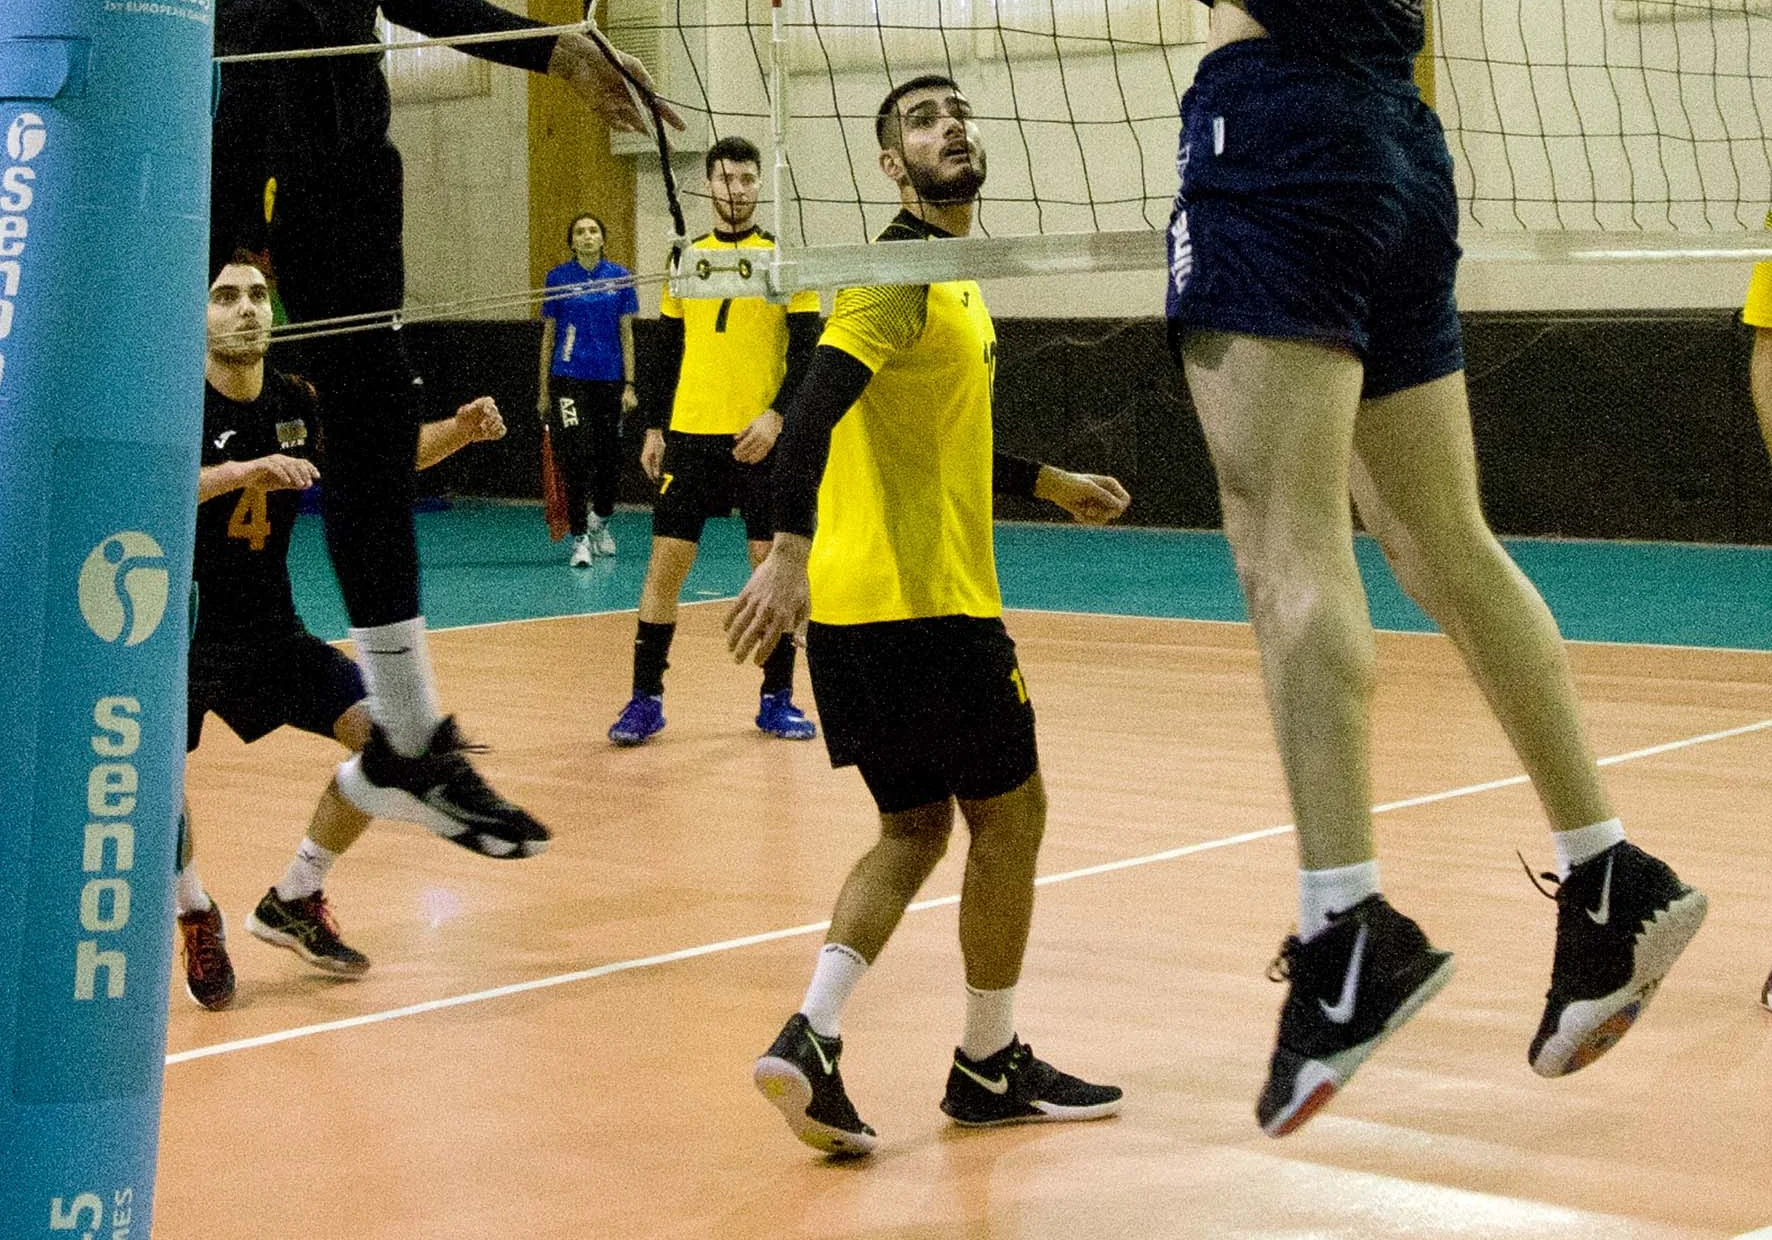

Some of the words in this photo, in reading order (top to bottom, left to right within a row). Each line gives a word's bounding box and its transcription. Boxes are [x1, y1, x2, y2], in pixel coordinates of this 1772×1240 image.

[0, 166, 37, 382] sen
[559, 397, 579, 429] AZE
[659, 472, 674, 495] 7
[227, 486, 271, 550] 4
[74, 696, 141, 1001] senoh
